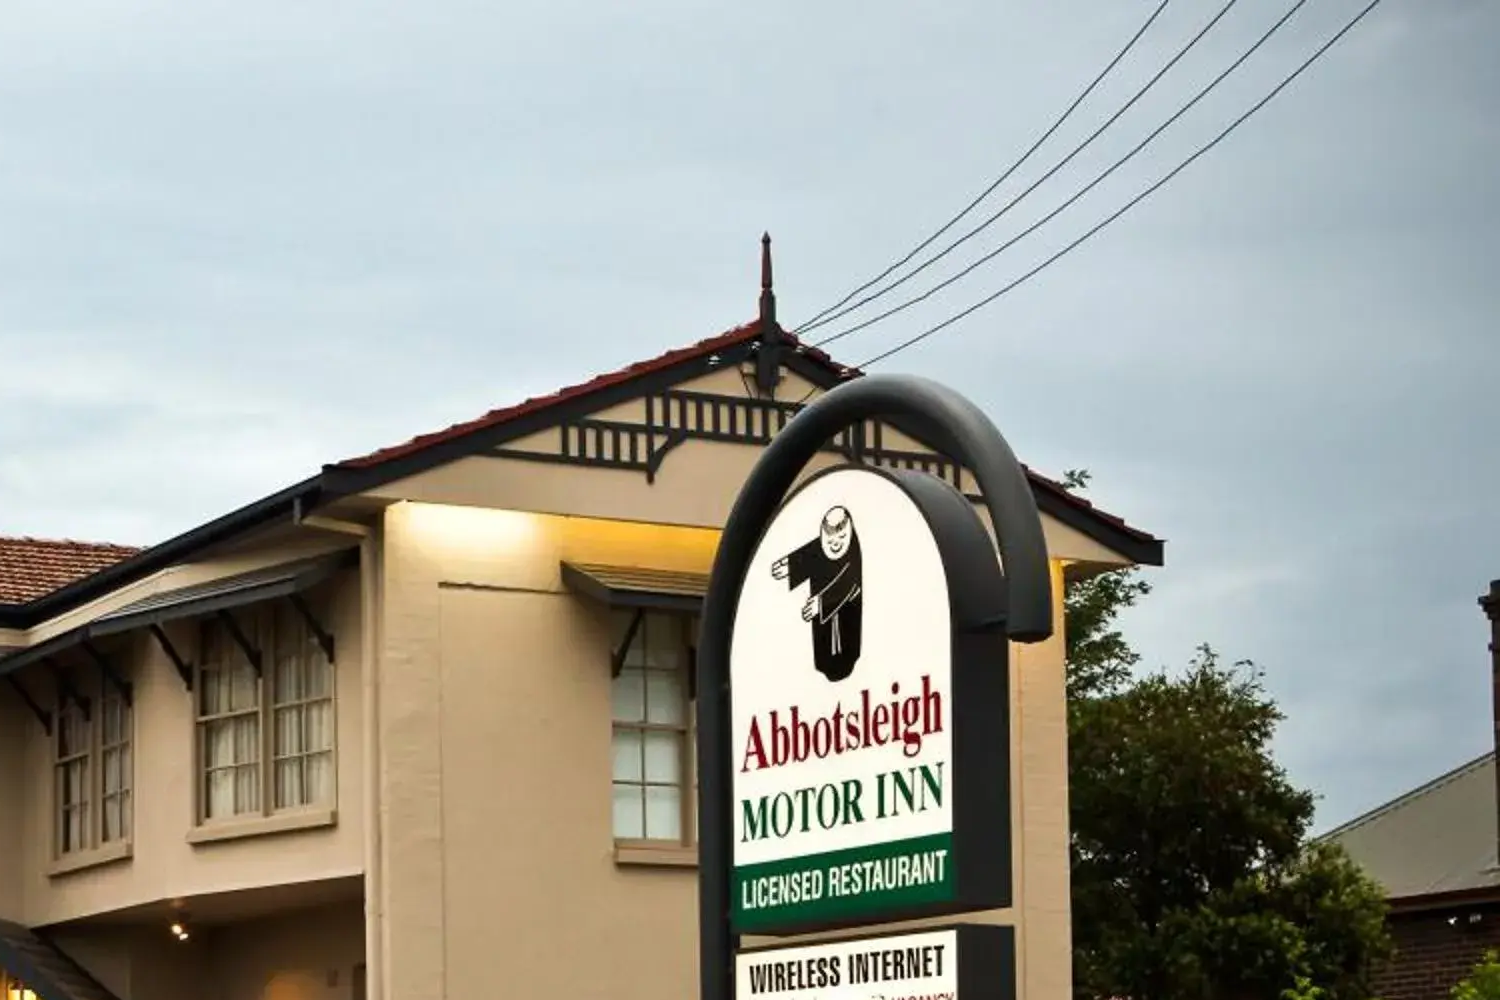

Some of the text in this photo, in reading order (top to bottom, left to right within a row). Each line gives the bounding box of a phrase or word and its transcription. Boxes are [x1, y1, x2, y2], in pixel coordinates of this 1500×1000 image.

[740, 675, 943, 772] Abbotsleigh
[740, 761, 944, 842] MOTOR INN
[741, 849, 947, 910] LICENSED RESTAURANT
[749, 944, 945, 994] WIRELESS INTERNET
